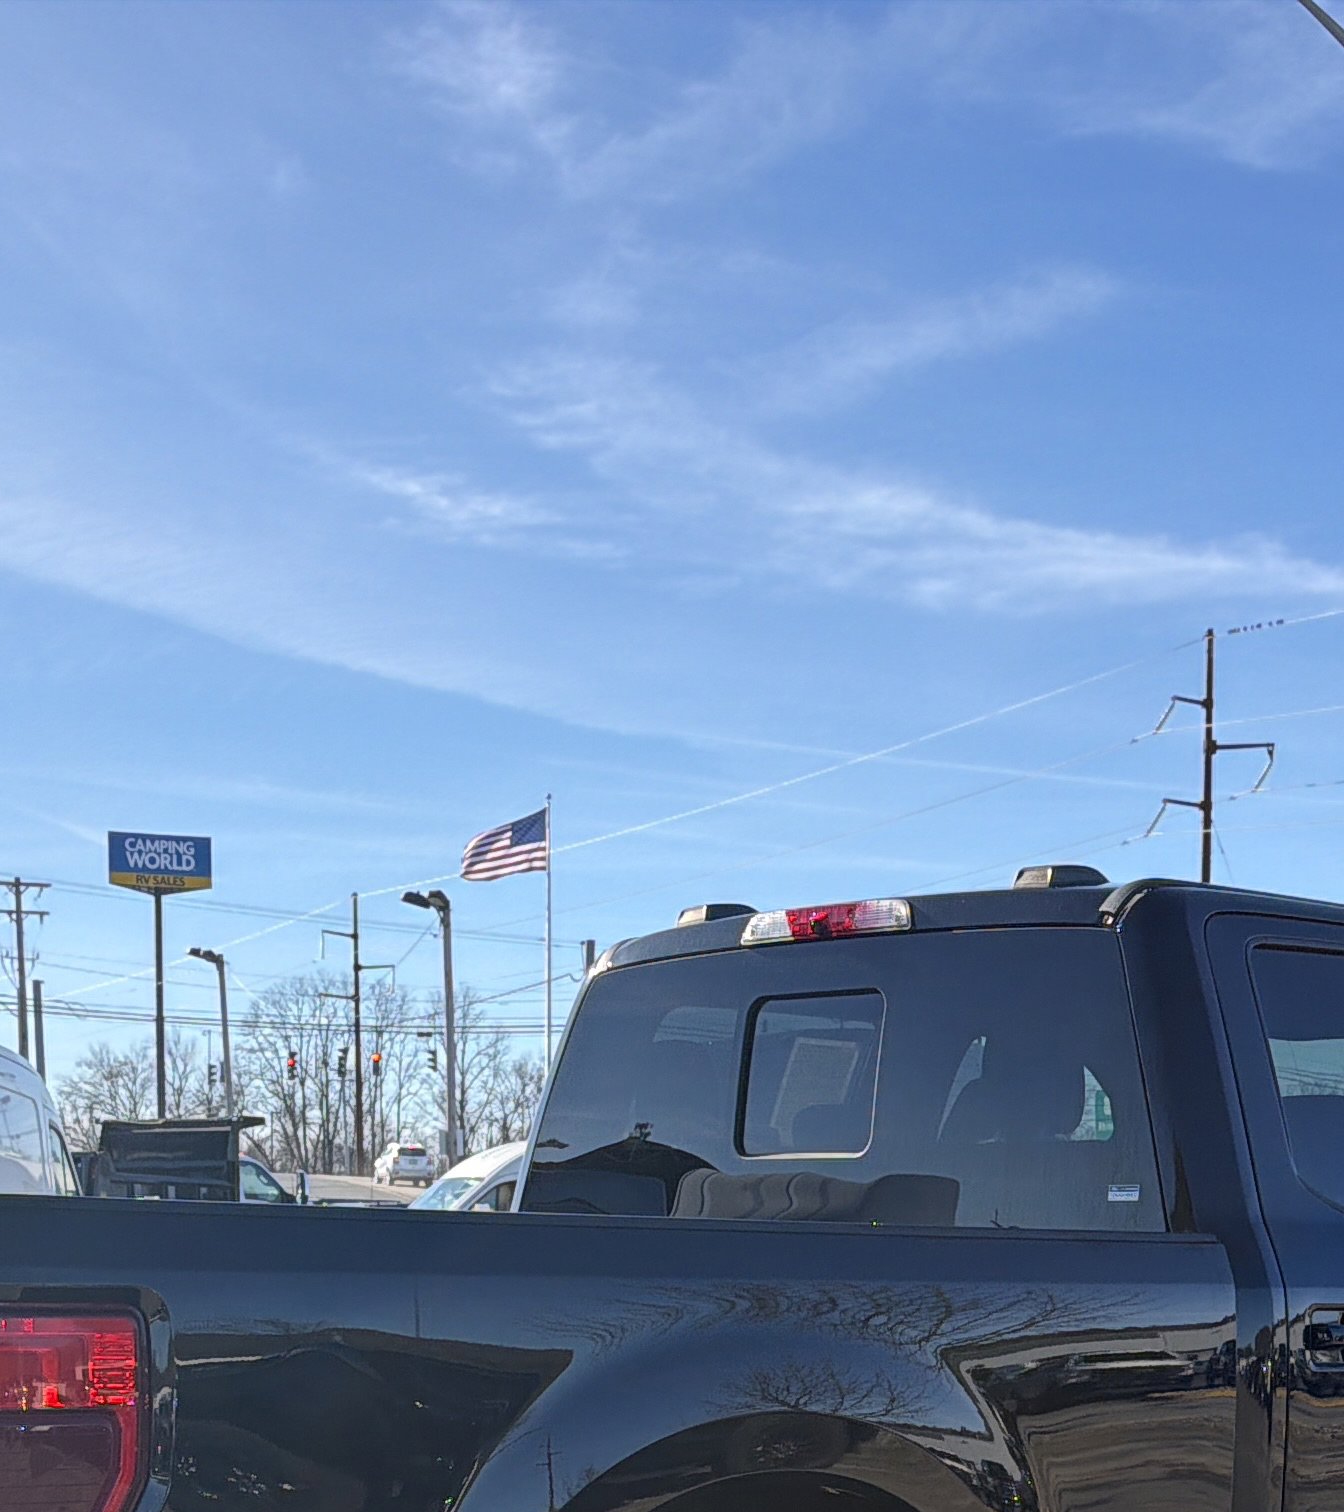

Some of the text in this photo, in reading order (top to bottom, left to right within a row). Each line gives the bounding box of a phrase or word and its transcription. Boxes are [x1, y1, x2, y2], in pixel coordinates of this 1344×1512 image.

[124, 837, 195, 855] CAMPING
[125, 850, 196, 871] WORLD
[136, 874, 186, 886] RV SALES
